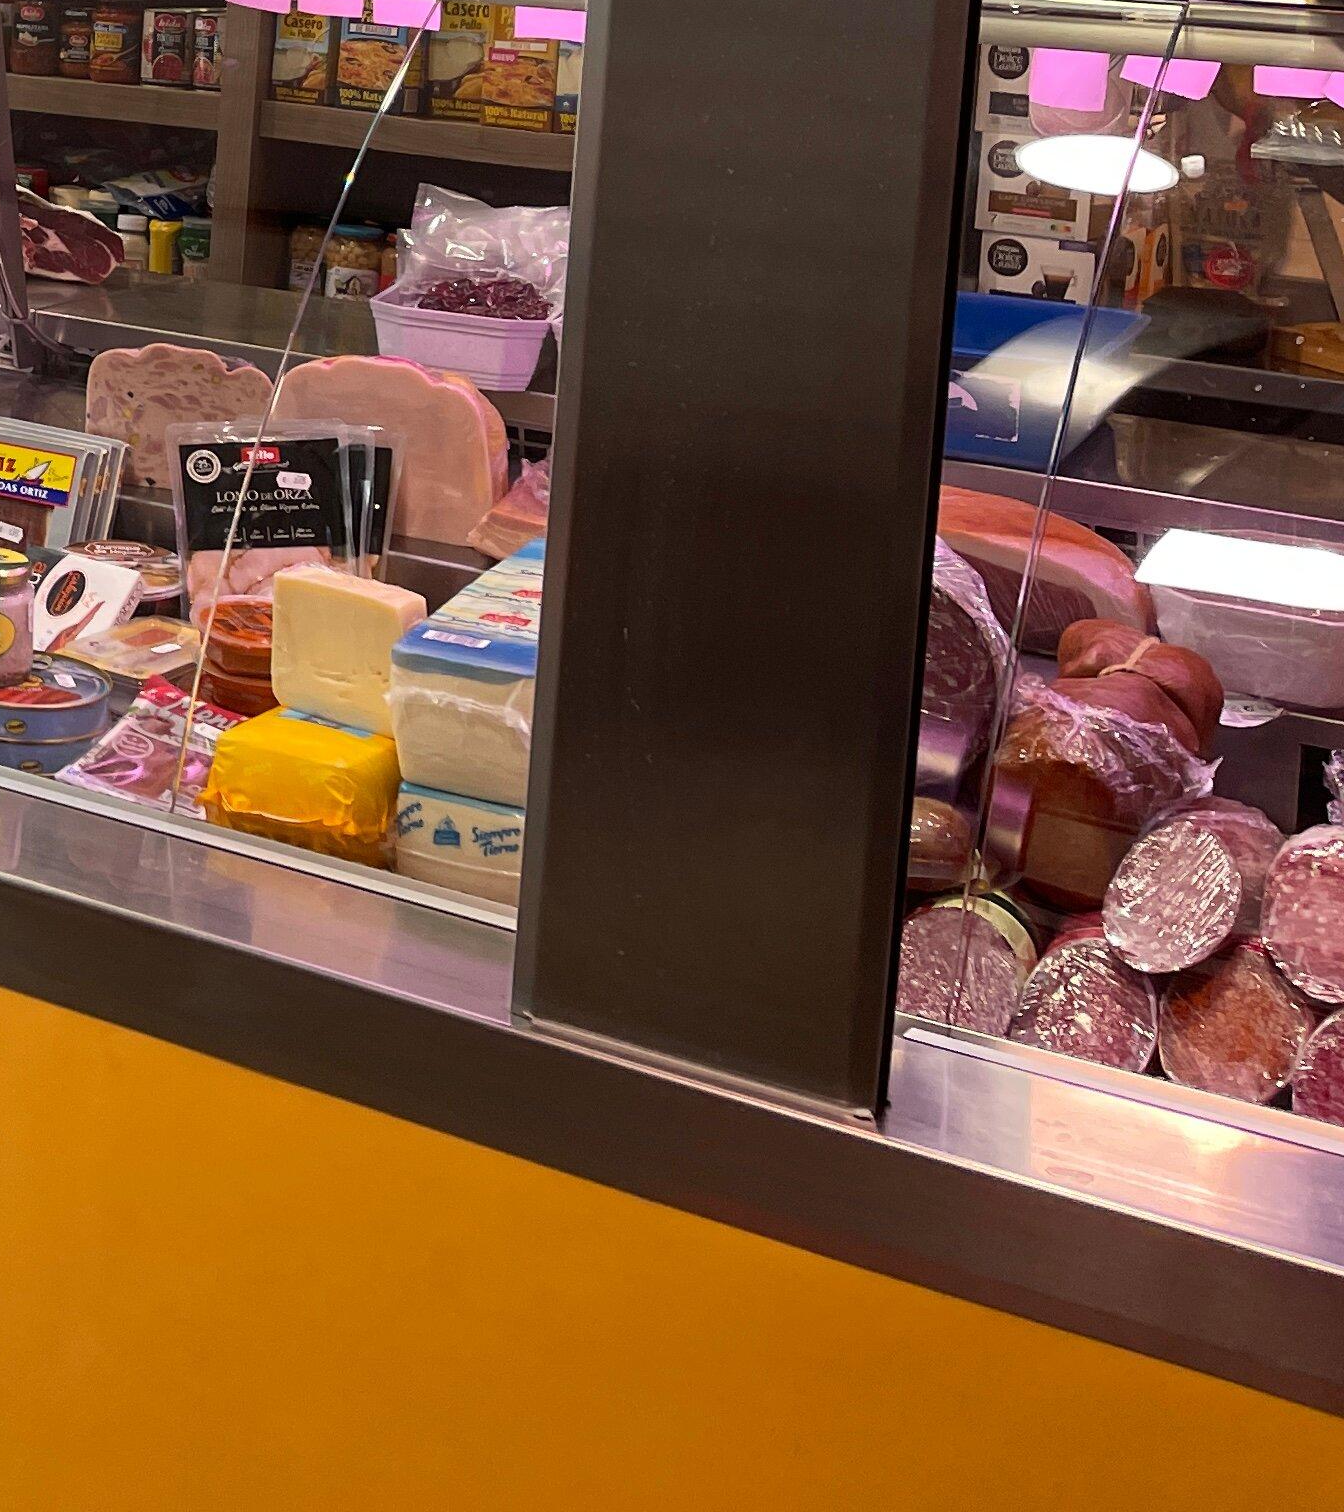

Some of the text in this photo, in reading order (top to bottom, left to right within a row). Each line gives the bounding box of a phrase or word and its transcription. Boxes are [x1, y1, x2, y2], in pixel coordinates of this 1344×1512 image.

[443, 0, 490, 18] Casero
[282, 16, 324, 30] Casero
[484, 104, 549, 123] 100% Natural
[19, 485, 49, 500] ORTIZ
[260, 492, 273, 501] DE
[273, 488, 314, 501] ORZA
